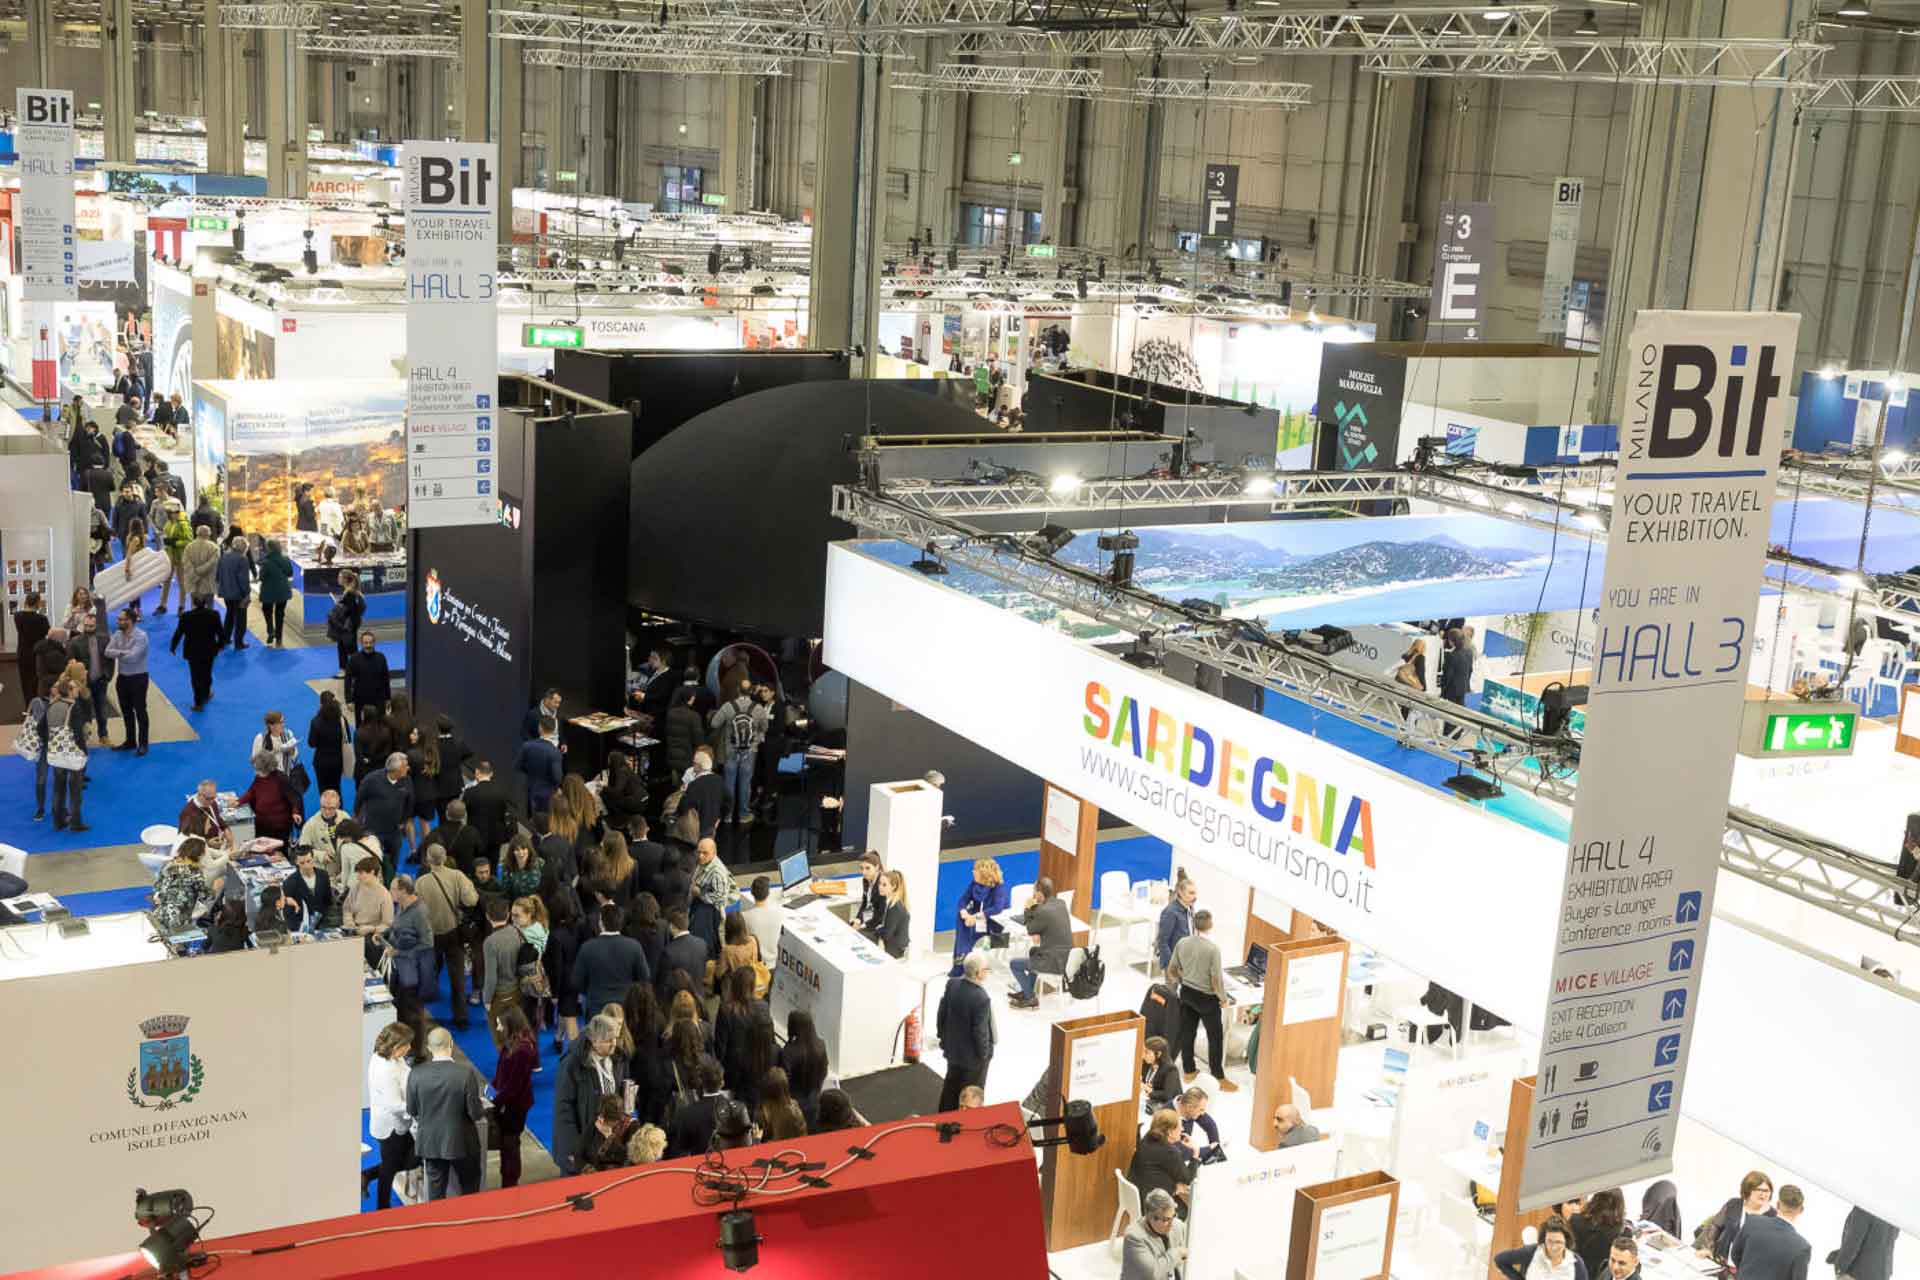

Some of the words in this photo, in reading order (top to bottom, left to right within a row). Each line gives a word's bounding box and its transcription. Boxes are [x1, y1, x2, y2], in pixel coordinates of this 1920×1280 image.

[27, 96, 70, 123] Bit
[22, 159, 58, 175] HALL
[64, 160, 73, 175] 3
[1216, 171, 1225, 187] 3
[421, 156, 492, 206] Bit
[1559, 183, 1581, 203] Bit
[410, 218, 445, 229] YOUR
[450, 218, 492, 230] TRAVEL
[1208, 200, 1231, 235] F
[1457, 214, 1472, 240] 3
[411, 273, 470, 299] HALL
[479, 273, 493, 299] 3
[1440, 263, 1480, 319] E
[592, 321, 646, 333] TOSCANA
[411, 367, 444, 382] HALL
[447, 367, 457, 381] 4
[1339, 378, 1383, 396] MARAVIGLIA
[1348, 369, 1375, 383] MOLISE
[1628, 344, 1657, 459] MILANO
[1648, 345, 1781, 459] Bit
[1623, 493, 1682, 516] YOUR
[1690, 490, 1762, 514] TRAVEL
[1626, 518, 1749, 543] EXHIBITION.
[1609, 588, 1640, 609] YOU
[1649, 586, 1677, 606] ARE
[1685, 585, 1701, 604] IN
[1598, 620, 1702, 684] HALL
[1715, 617, 1746, 673] 3
[1082, 680, 1376, 870] SARDEGNA
[1080, 745, 1375, 913] www.sardegnaturismo.it
[1570, 839, 1630, 876] HALL
[1638, 834, 1655, 865] 4
[1567, 875, 1639, 901] EXHIBITION
[1641, 868, 1673, 890] AREA
[1614, 897, 1657, 916] Lounge
[1560, 922, 1632, 945] Conference
[778, 944, 821, 992] DEGNA
[1555, 972, 1599, 993] MICE
[1602, 962, 1655, 986] VILLAGE
[1551, 1006, 1574, 1026] EXIT
[1576, 999, 1635, 1021] RECEPTION
[1548, 1028, 1573, 1046] Gate
[1576, 1023, 1585, 1039] 4
[89, 1125, 150, 1144] COMUNE
[153, 1122, 167, 1134] DI
[170, 1110, 249, 1132] FAVIGNANA
[127, 1136, 166, 1152] ISOLE
[169, 1128, 210, 1145] EGADI
